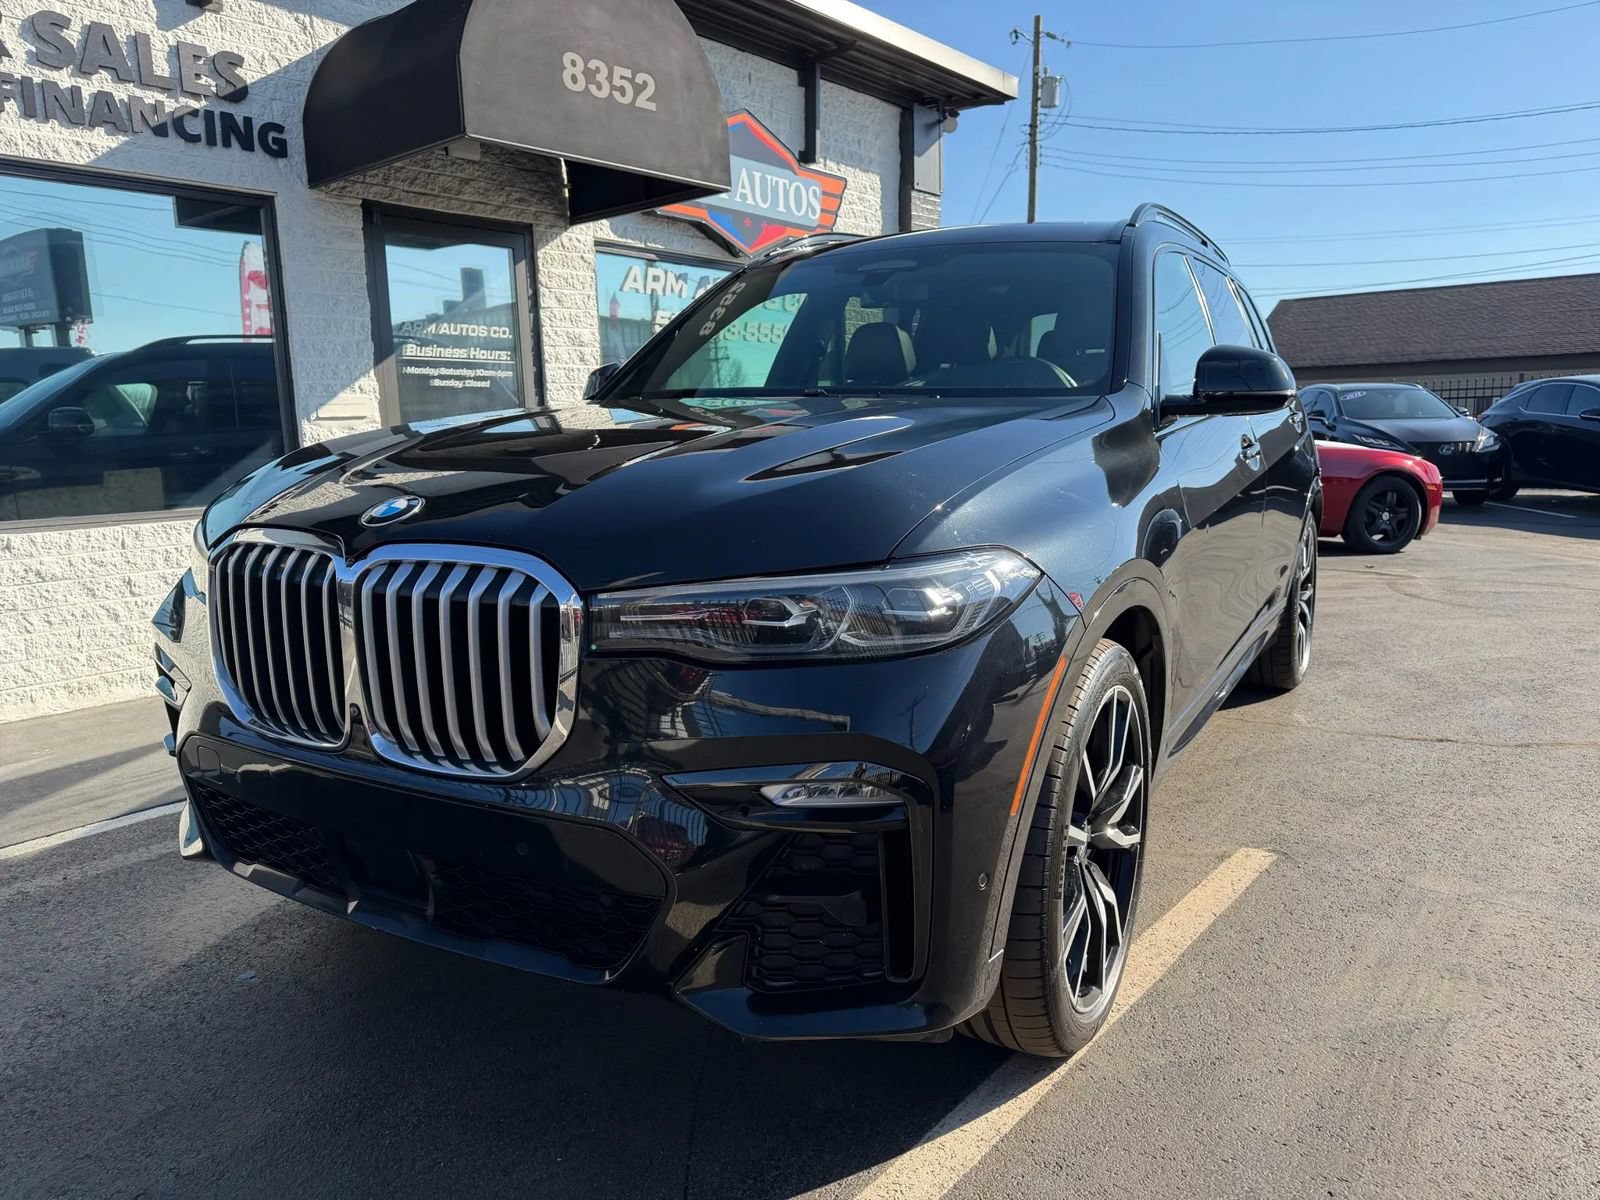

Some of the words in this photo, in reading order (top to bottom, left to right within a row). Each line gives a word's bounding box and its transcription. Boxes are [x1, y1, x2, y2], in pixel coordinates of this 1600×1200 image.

[32, 10, 249, 103] SALES
[561, 51, 656, 111] 8352
[0, 72, 289, 158] FINANCING
[736, 168, 822, 219] AUTOS
[620, 264, 688, 298] ARM
[406, 344, 468, 359] Business
[470, 346, 512, 360] Hours:
[439, 322, 488, 337] AUTOS
[490, 326, 513, 339] CO.
